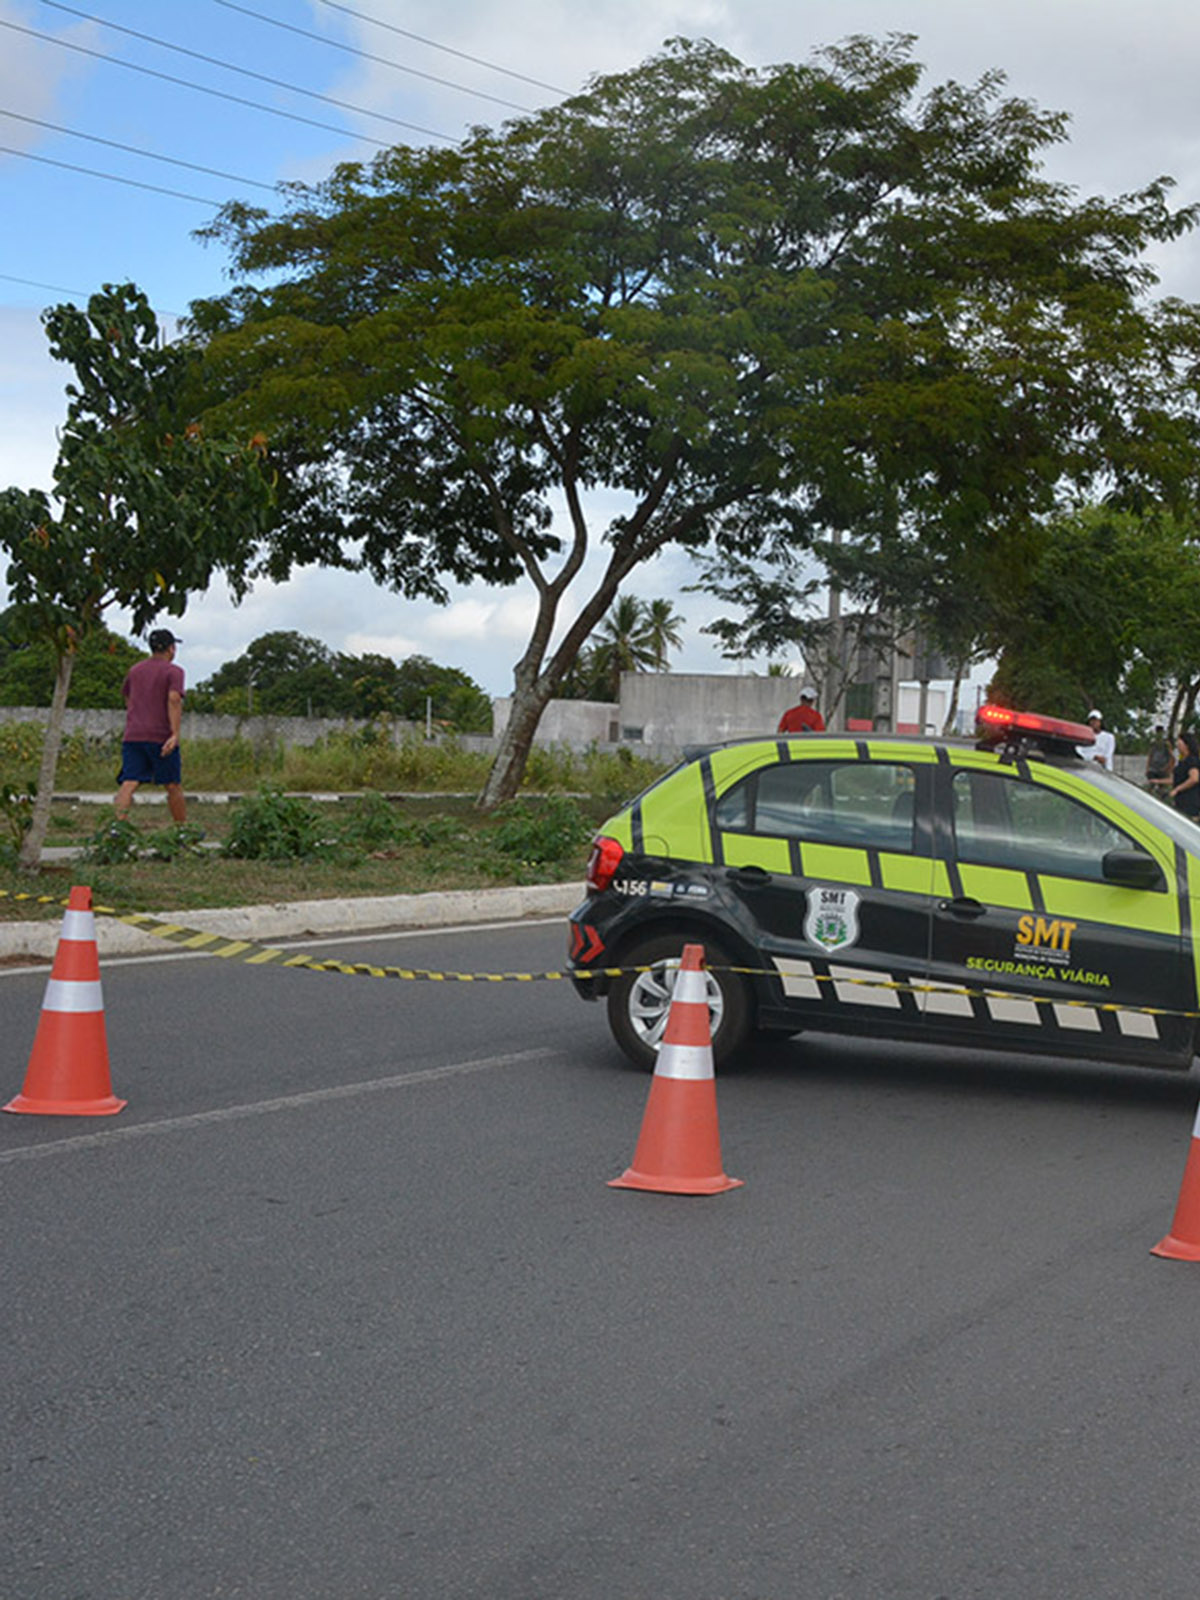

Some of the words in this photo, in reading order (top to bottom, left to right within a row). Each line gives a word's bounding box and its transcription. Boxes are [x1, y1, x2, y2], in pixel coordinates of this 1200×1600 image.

[622, 880, 648, 896] 156
[820, 890, 847, 905] SMT
[1016, 914, 1077, 951] SMT
[966, 956, 1056, 980] SEGURANÇA
[1060, 968, 1111, 987] VIÁRIA
